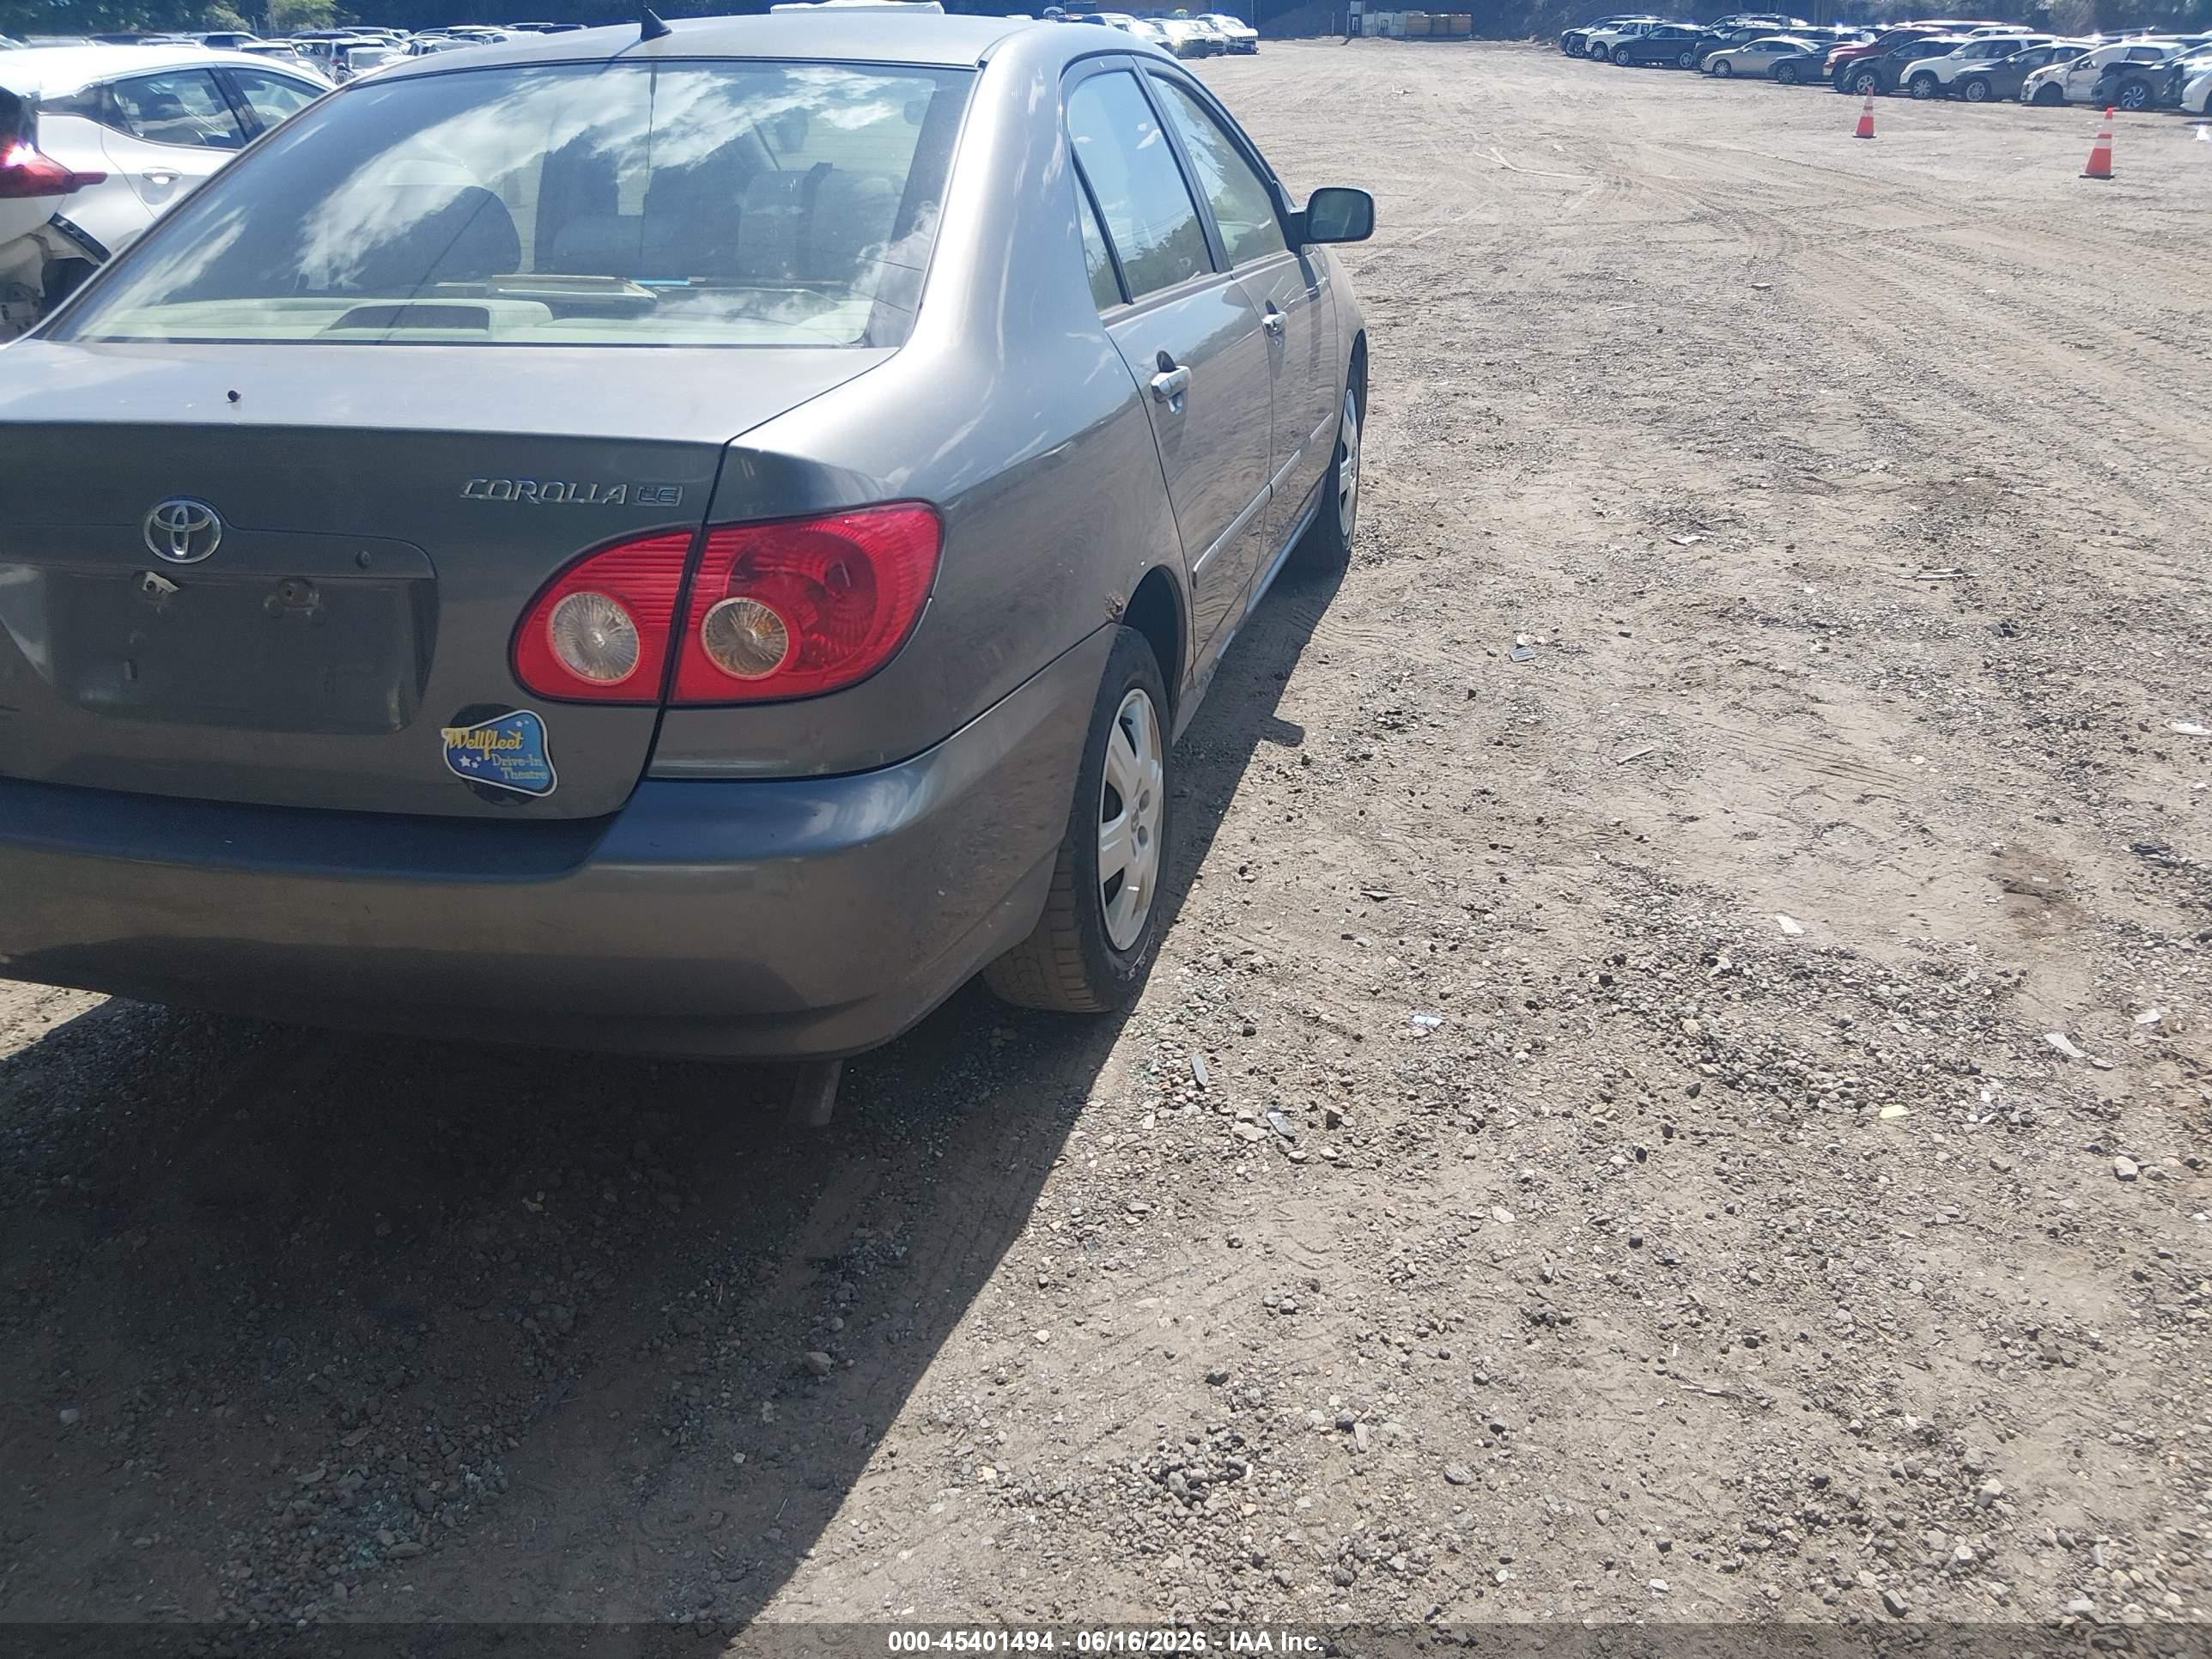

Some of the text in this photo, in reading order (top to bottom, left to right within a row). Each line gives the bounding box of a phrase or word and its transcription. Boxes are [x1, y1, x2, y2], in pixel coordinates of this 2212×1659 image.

[460, 478, 683, 507] COROLLA LE
[441, 728, 524, 761] Wellfleet
[491, 753, 544, 767] Drive-In
